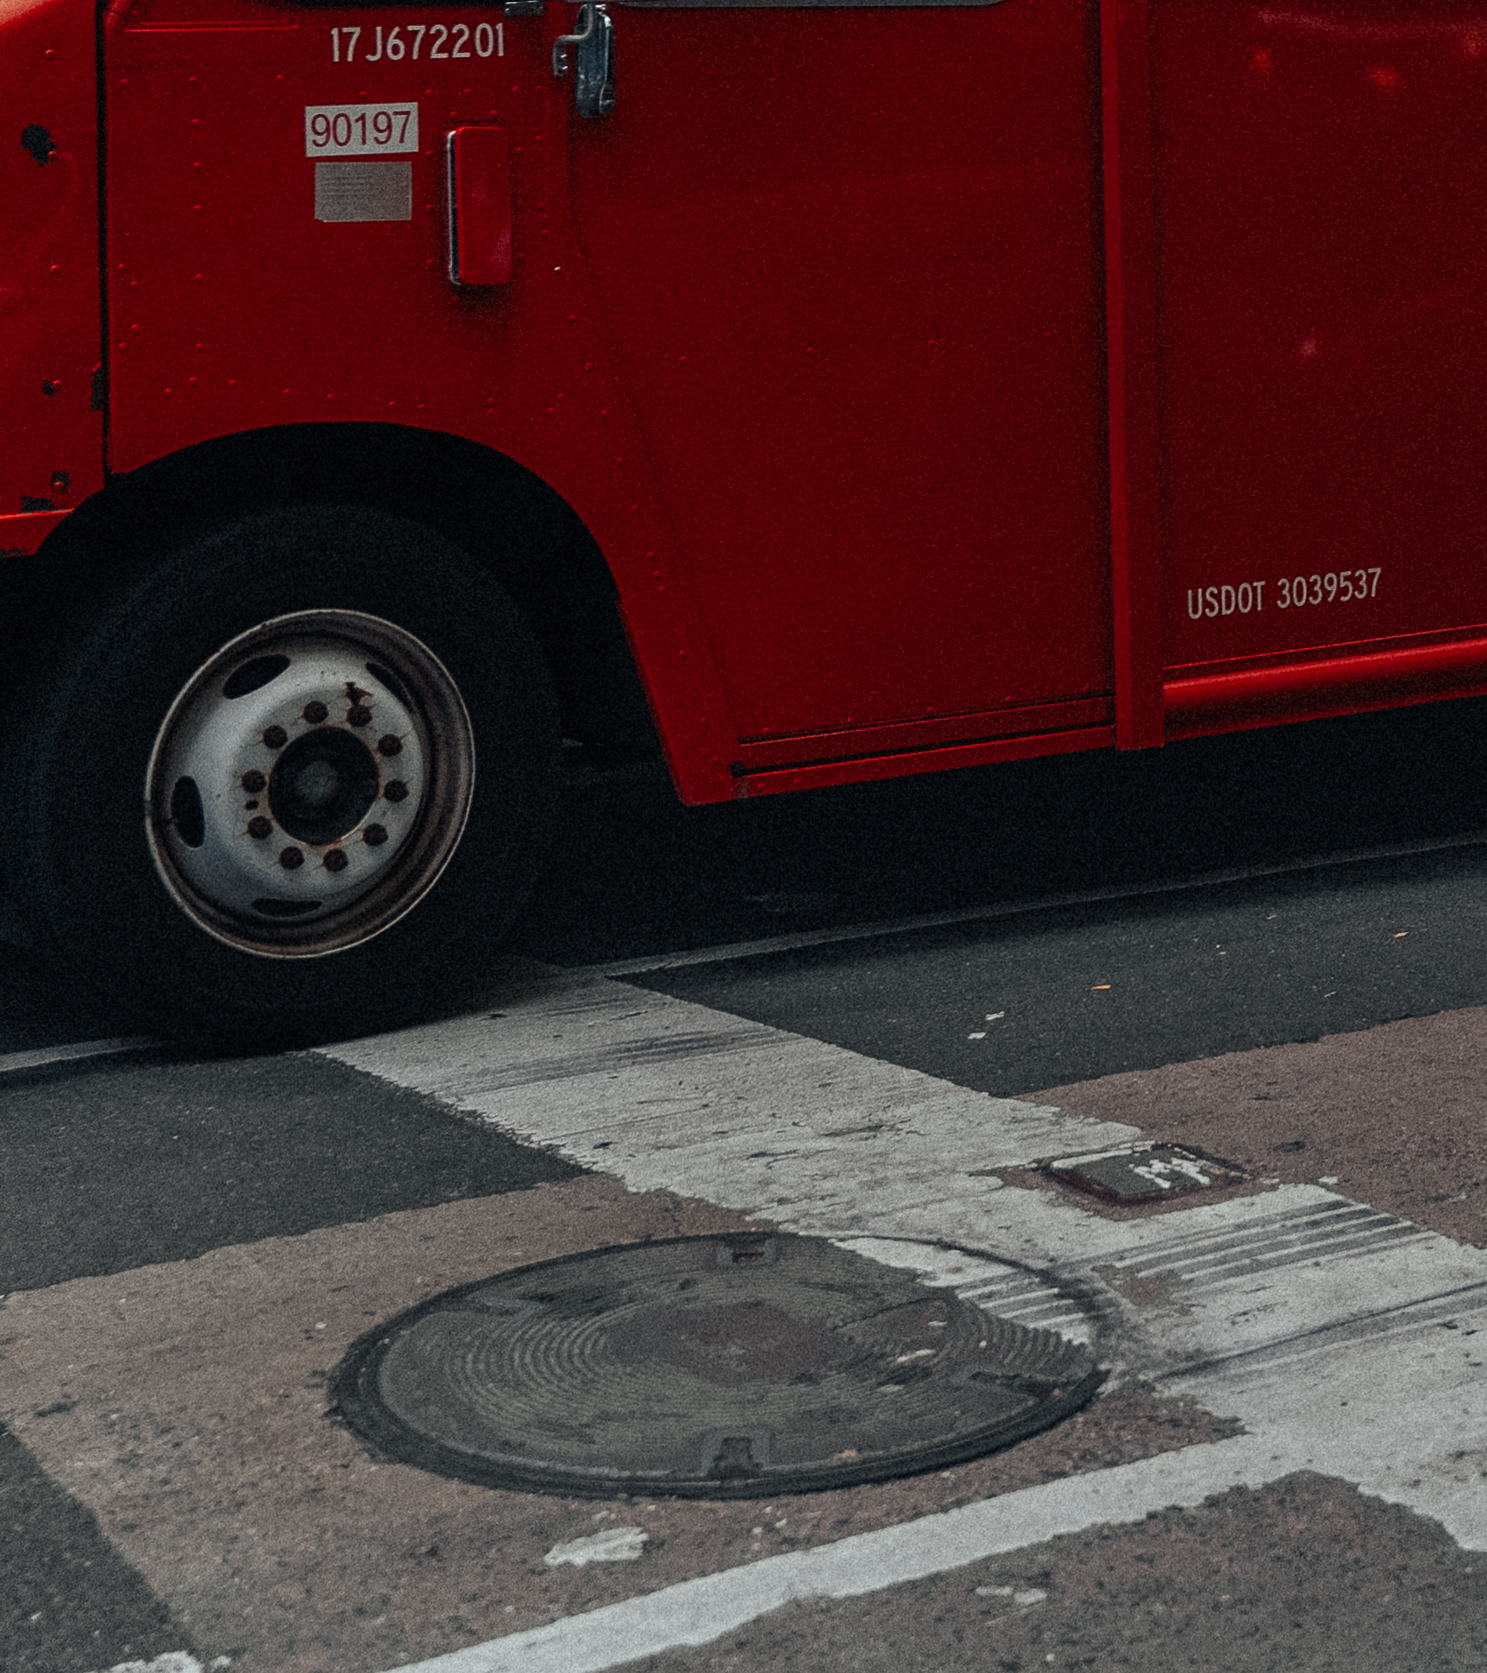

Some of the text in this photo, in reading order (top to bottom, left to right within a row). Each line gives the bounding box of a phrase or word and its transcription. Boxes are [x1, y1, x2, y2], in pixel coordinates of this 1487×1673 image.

[331, 22, 504, 62] 17J672201
[311, 111, 412, 148] 90197
[1187, 565, 1383, 621] USDOT 3039537
